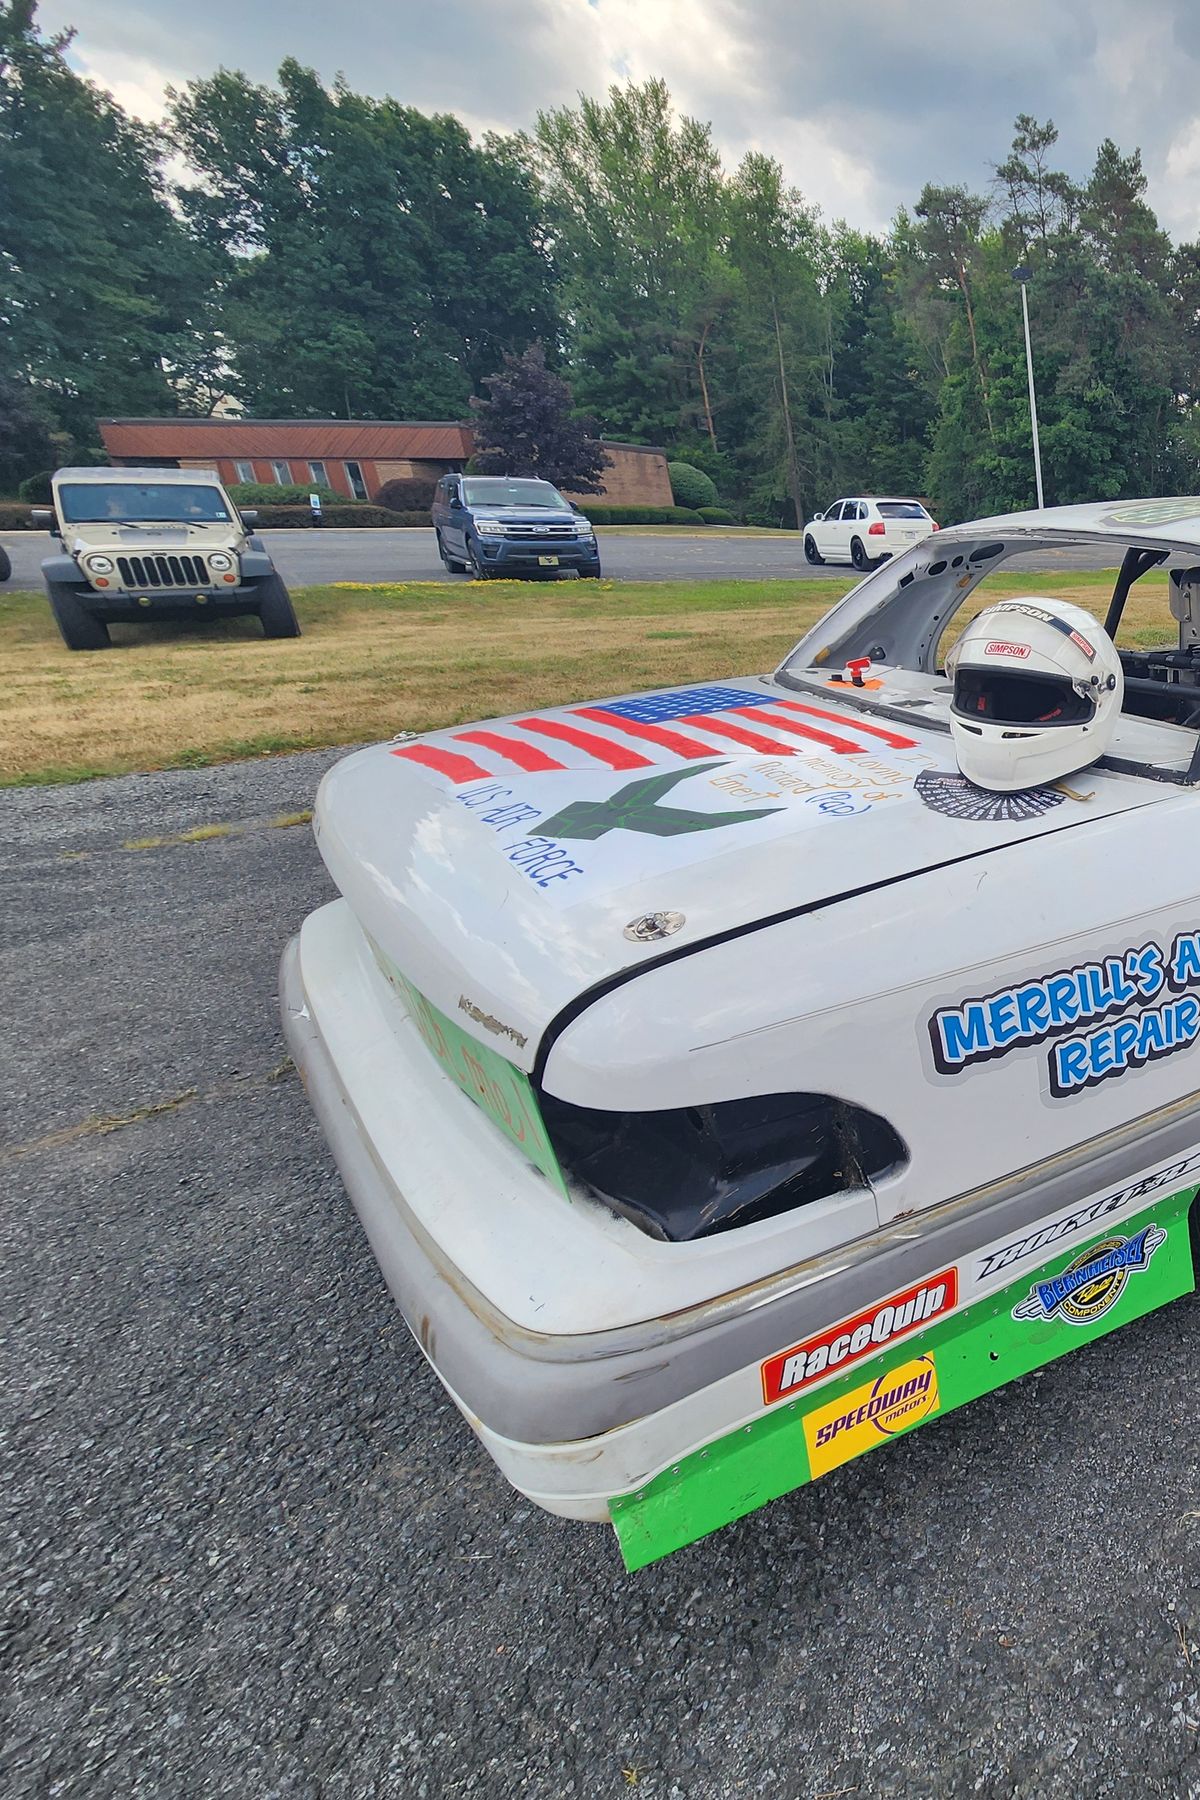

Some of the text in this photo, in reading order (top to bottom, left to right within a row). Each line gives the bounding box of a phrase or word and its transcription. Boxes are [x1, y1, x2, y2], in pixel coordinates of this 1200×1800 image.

[979, 602, 1054, 624] SIMPSON
[988, 644, 1026, 656] SIMPSON
[1072, 632, 1093, 657] SIMPSON
[476, 801, 542, 832] AIR
[502, 838, 584, 888] FORCE
[938, 945, 1165, 1062] MERRILL'S
[1056, 997, 1200, 1086] REPAIR
[976, 1183, 1144, 1282] ROCKET
[1037, 1229, 1147, 1311] BERNHEISEL
[1063, 1270, 1125, 1317] COMPONENTS
[779, 1283, 946, 1391] RaceQuip
[815, 1369, 933, 1449] SPEEDWAY
[885, 1395, 928, 1424] motors
